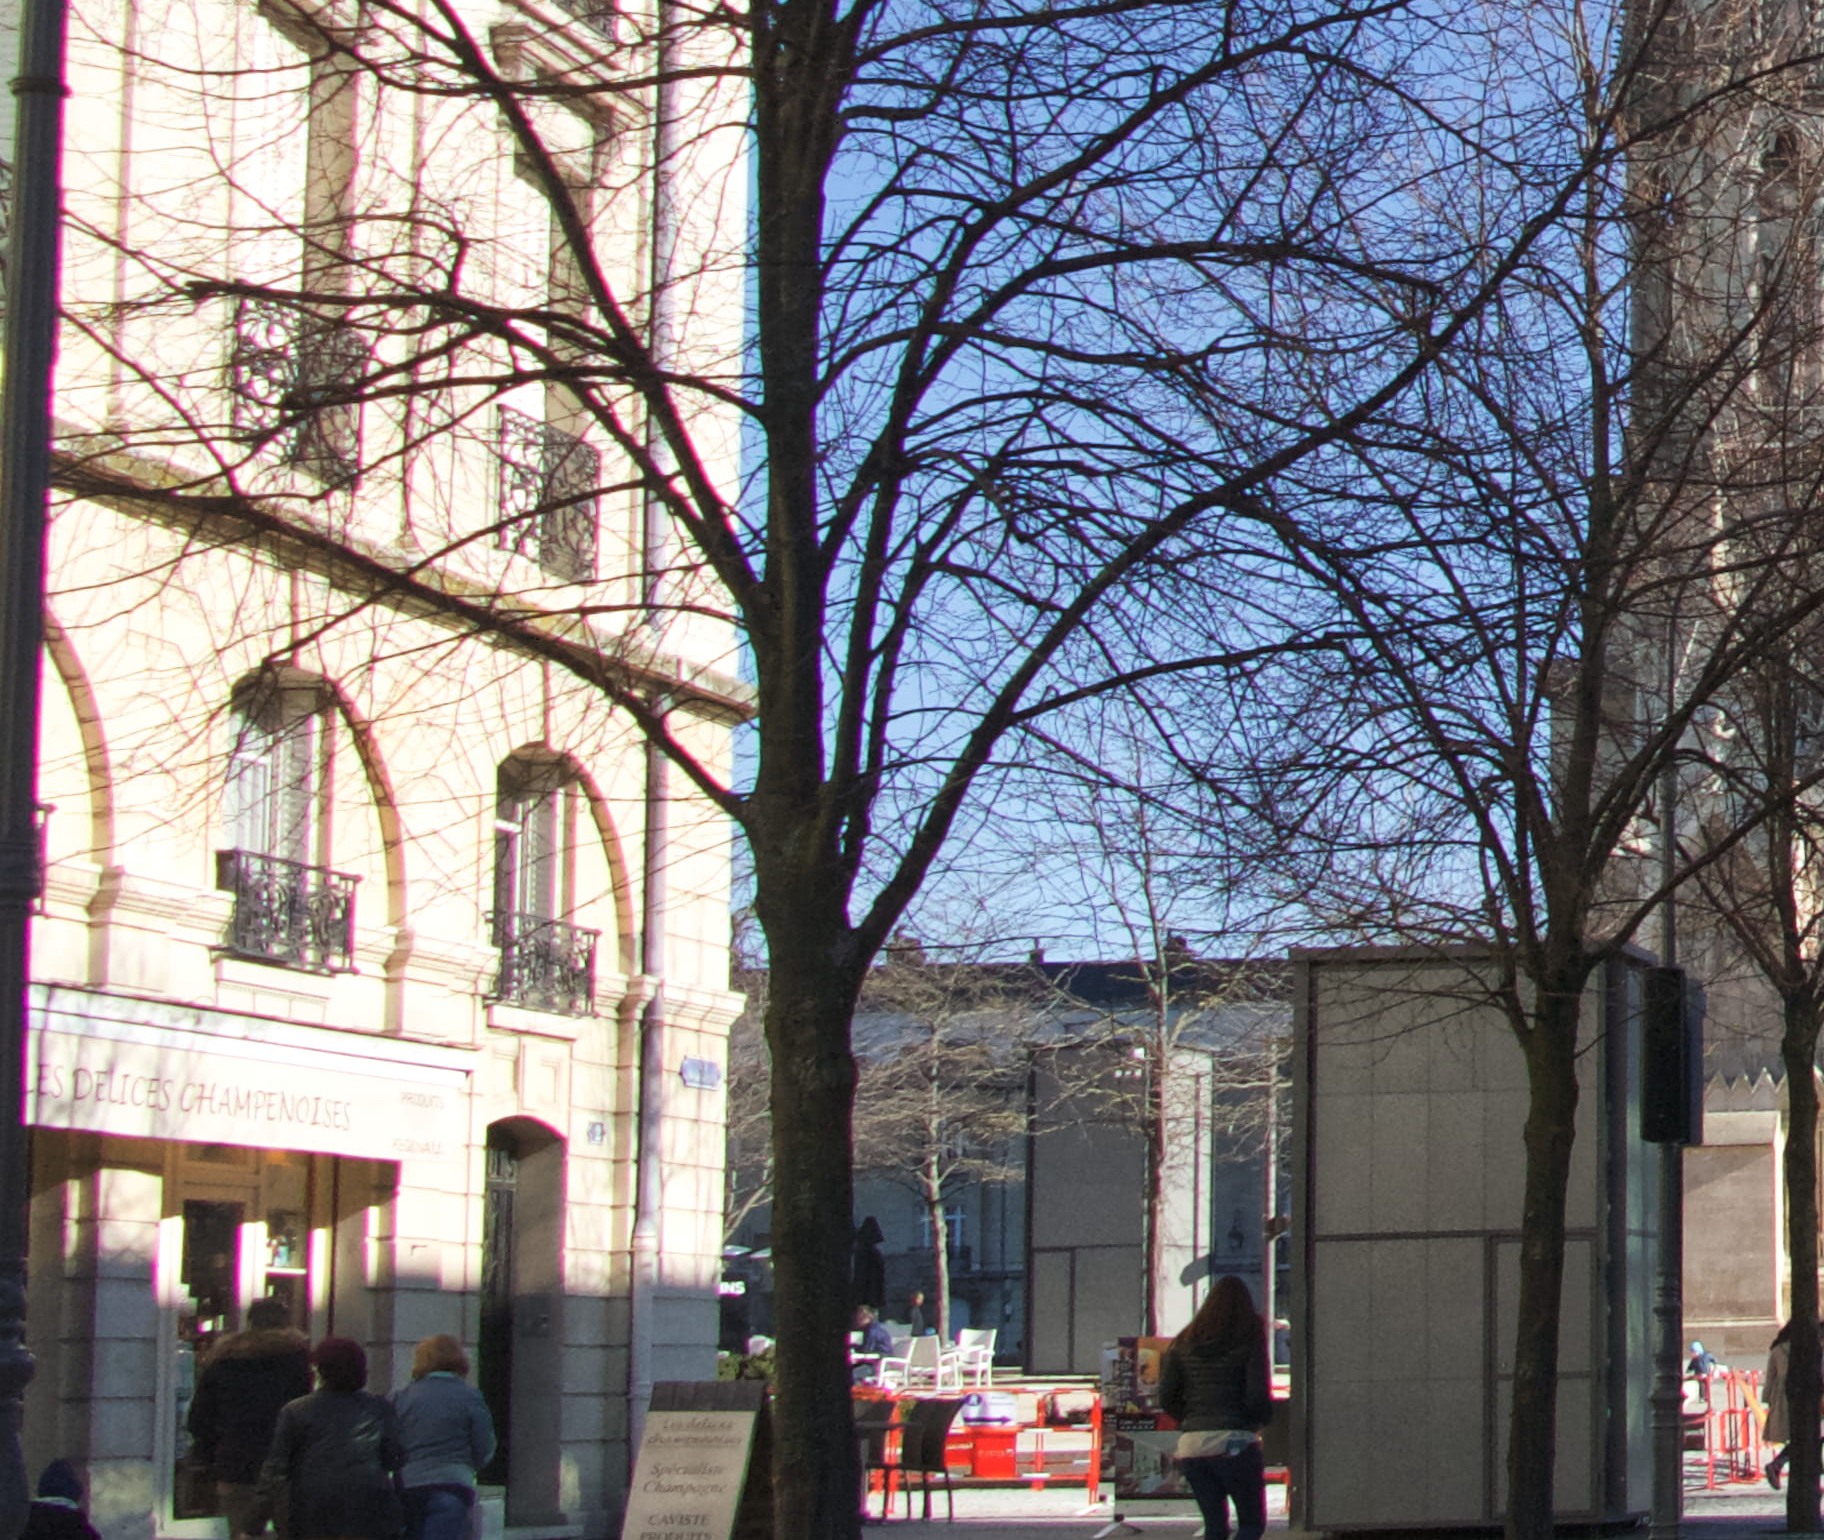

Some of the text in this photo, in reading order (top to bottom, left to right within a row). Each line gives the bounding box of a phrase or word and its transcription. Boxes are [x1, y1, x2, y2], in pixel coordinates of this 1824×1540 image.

[27, 1064, 64, 1099] ES
[180, 1081, 351, 1131] CHAMPENOISES
[643, 1480, 727, 1497] Champagne
[648, 1514, 711, 1526] CAVISTE
